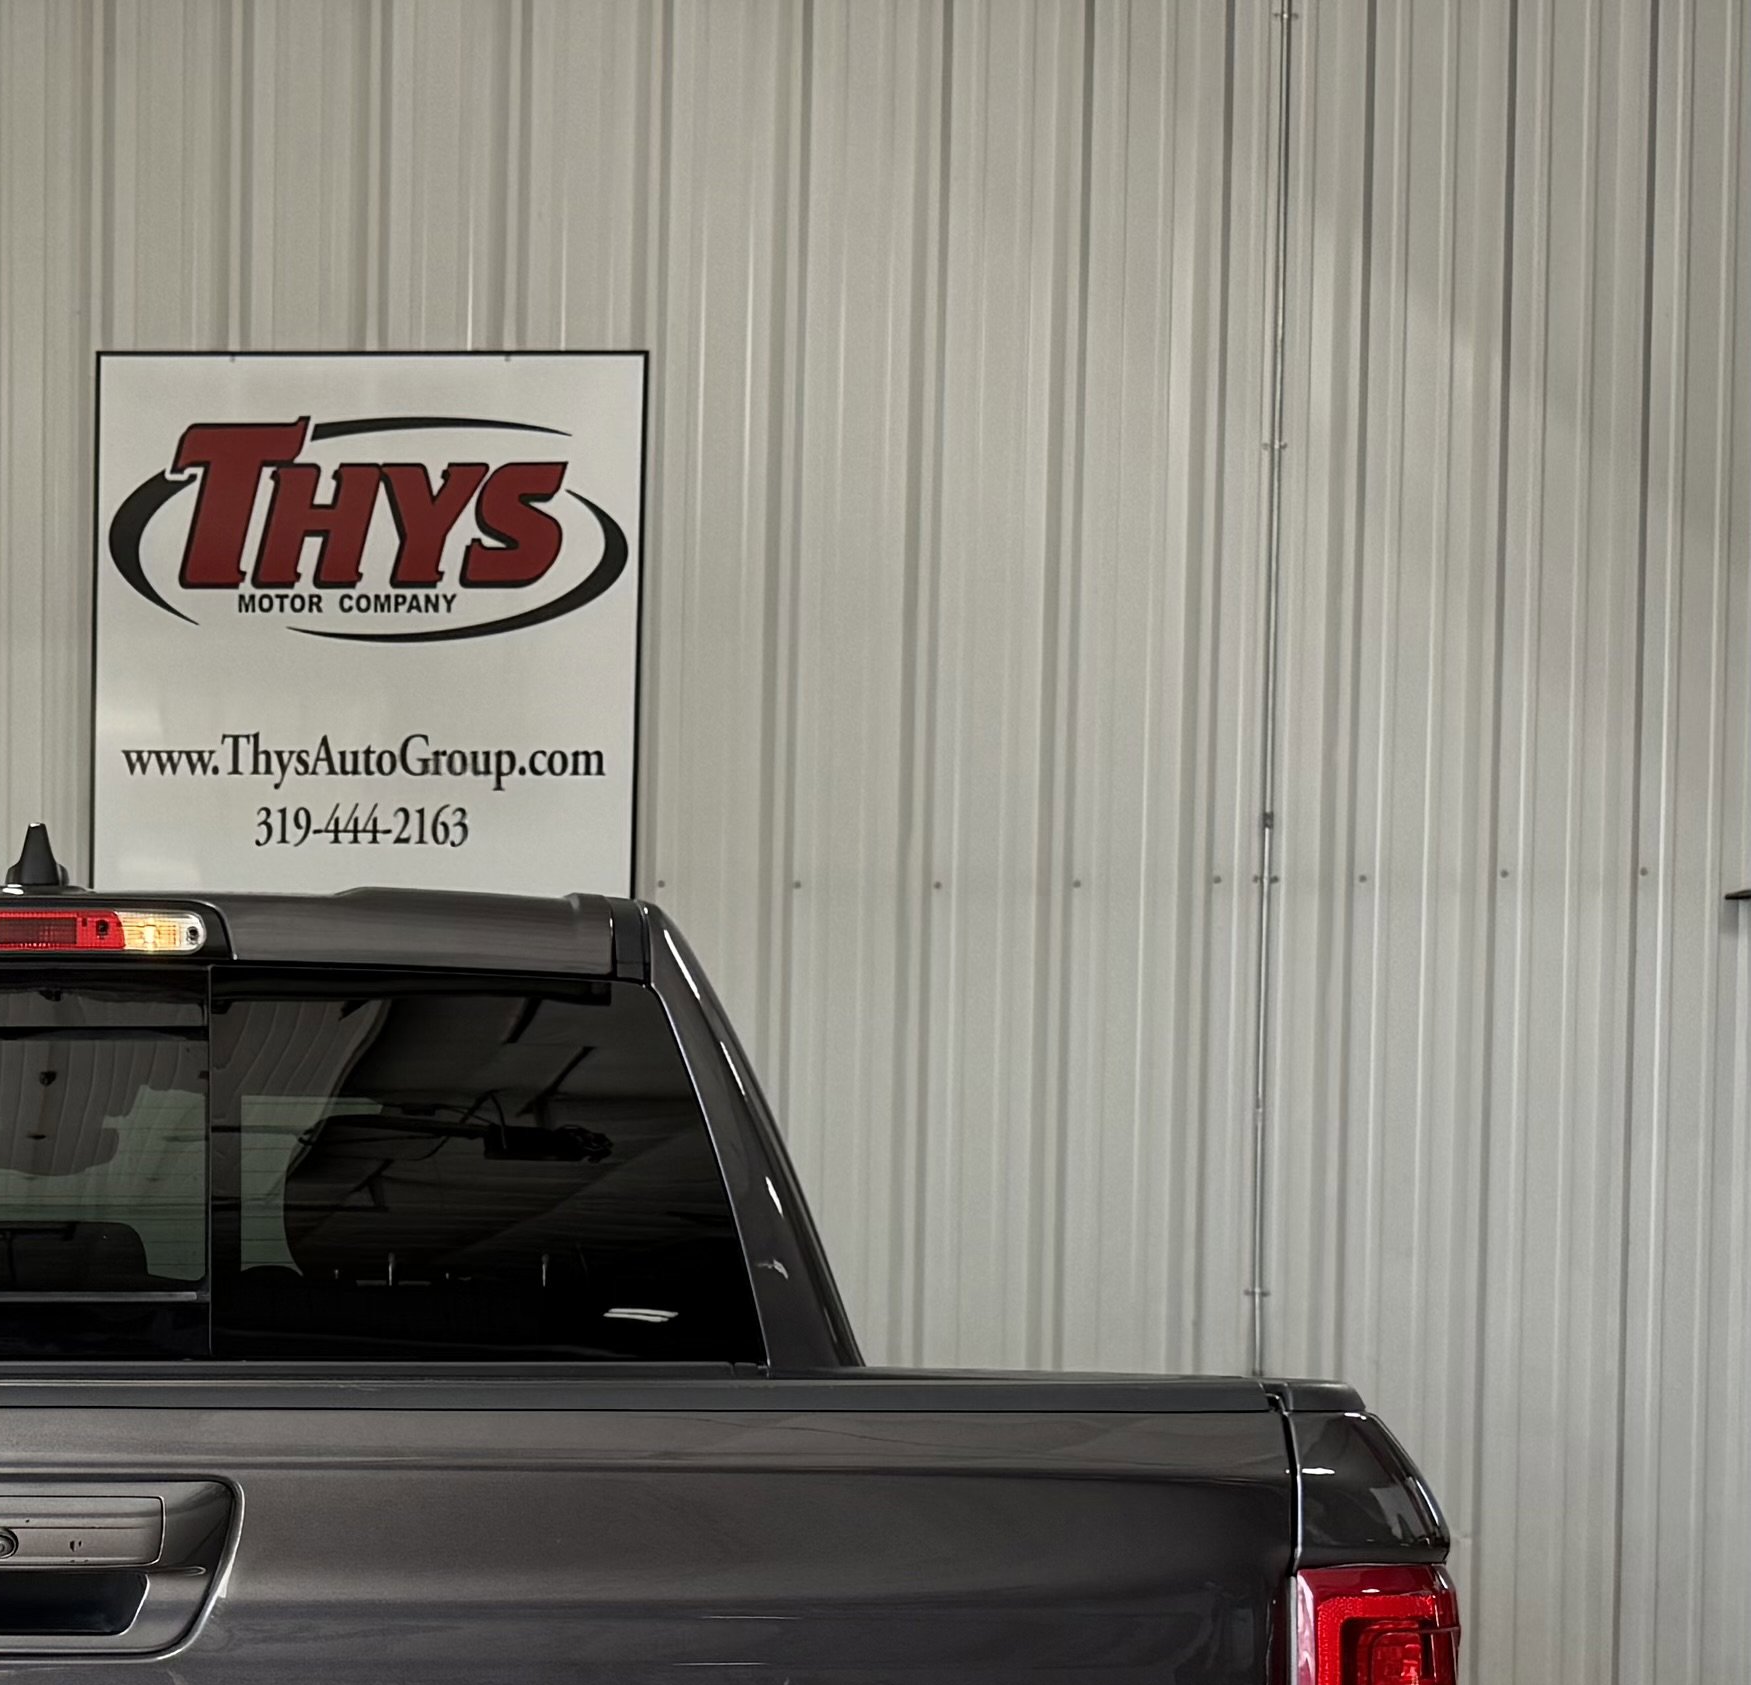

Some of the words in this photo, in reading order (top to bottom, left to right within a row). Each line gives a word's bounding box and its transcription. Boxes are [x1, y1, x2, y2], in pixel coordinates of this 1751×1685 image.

[168, 416, 568, 589] THYS
[238, 593, 323, 613] MOTOR
[339, 593, 457, 613] COMPANY
[121, 731, 606, 791] www.ThysAutoGroup.com
[254, 803, 469, 847] 319-444-2163
